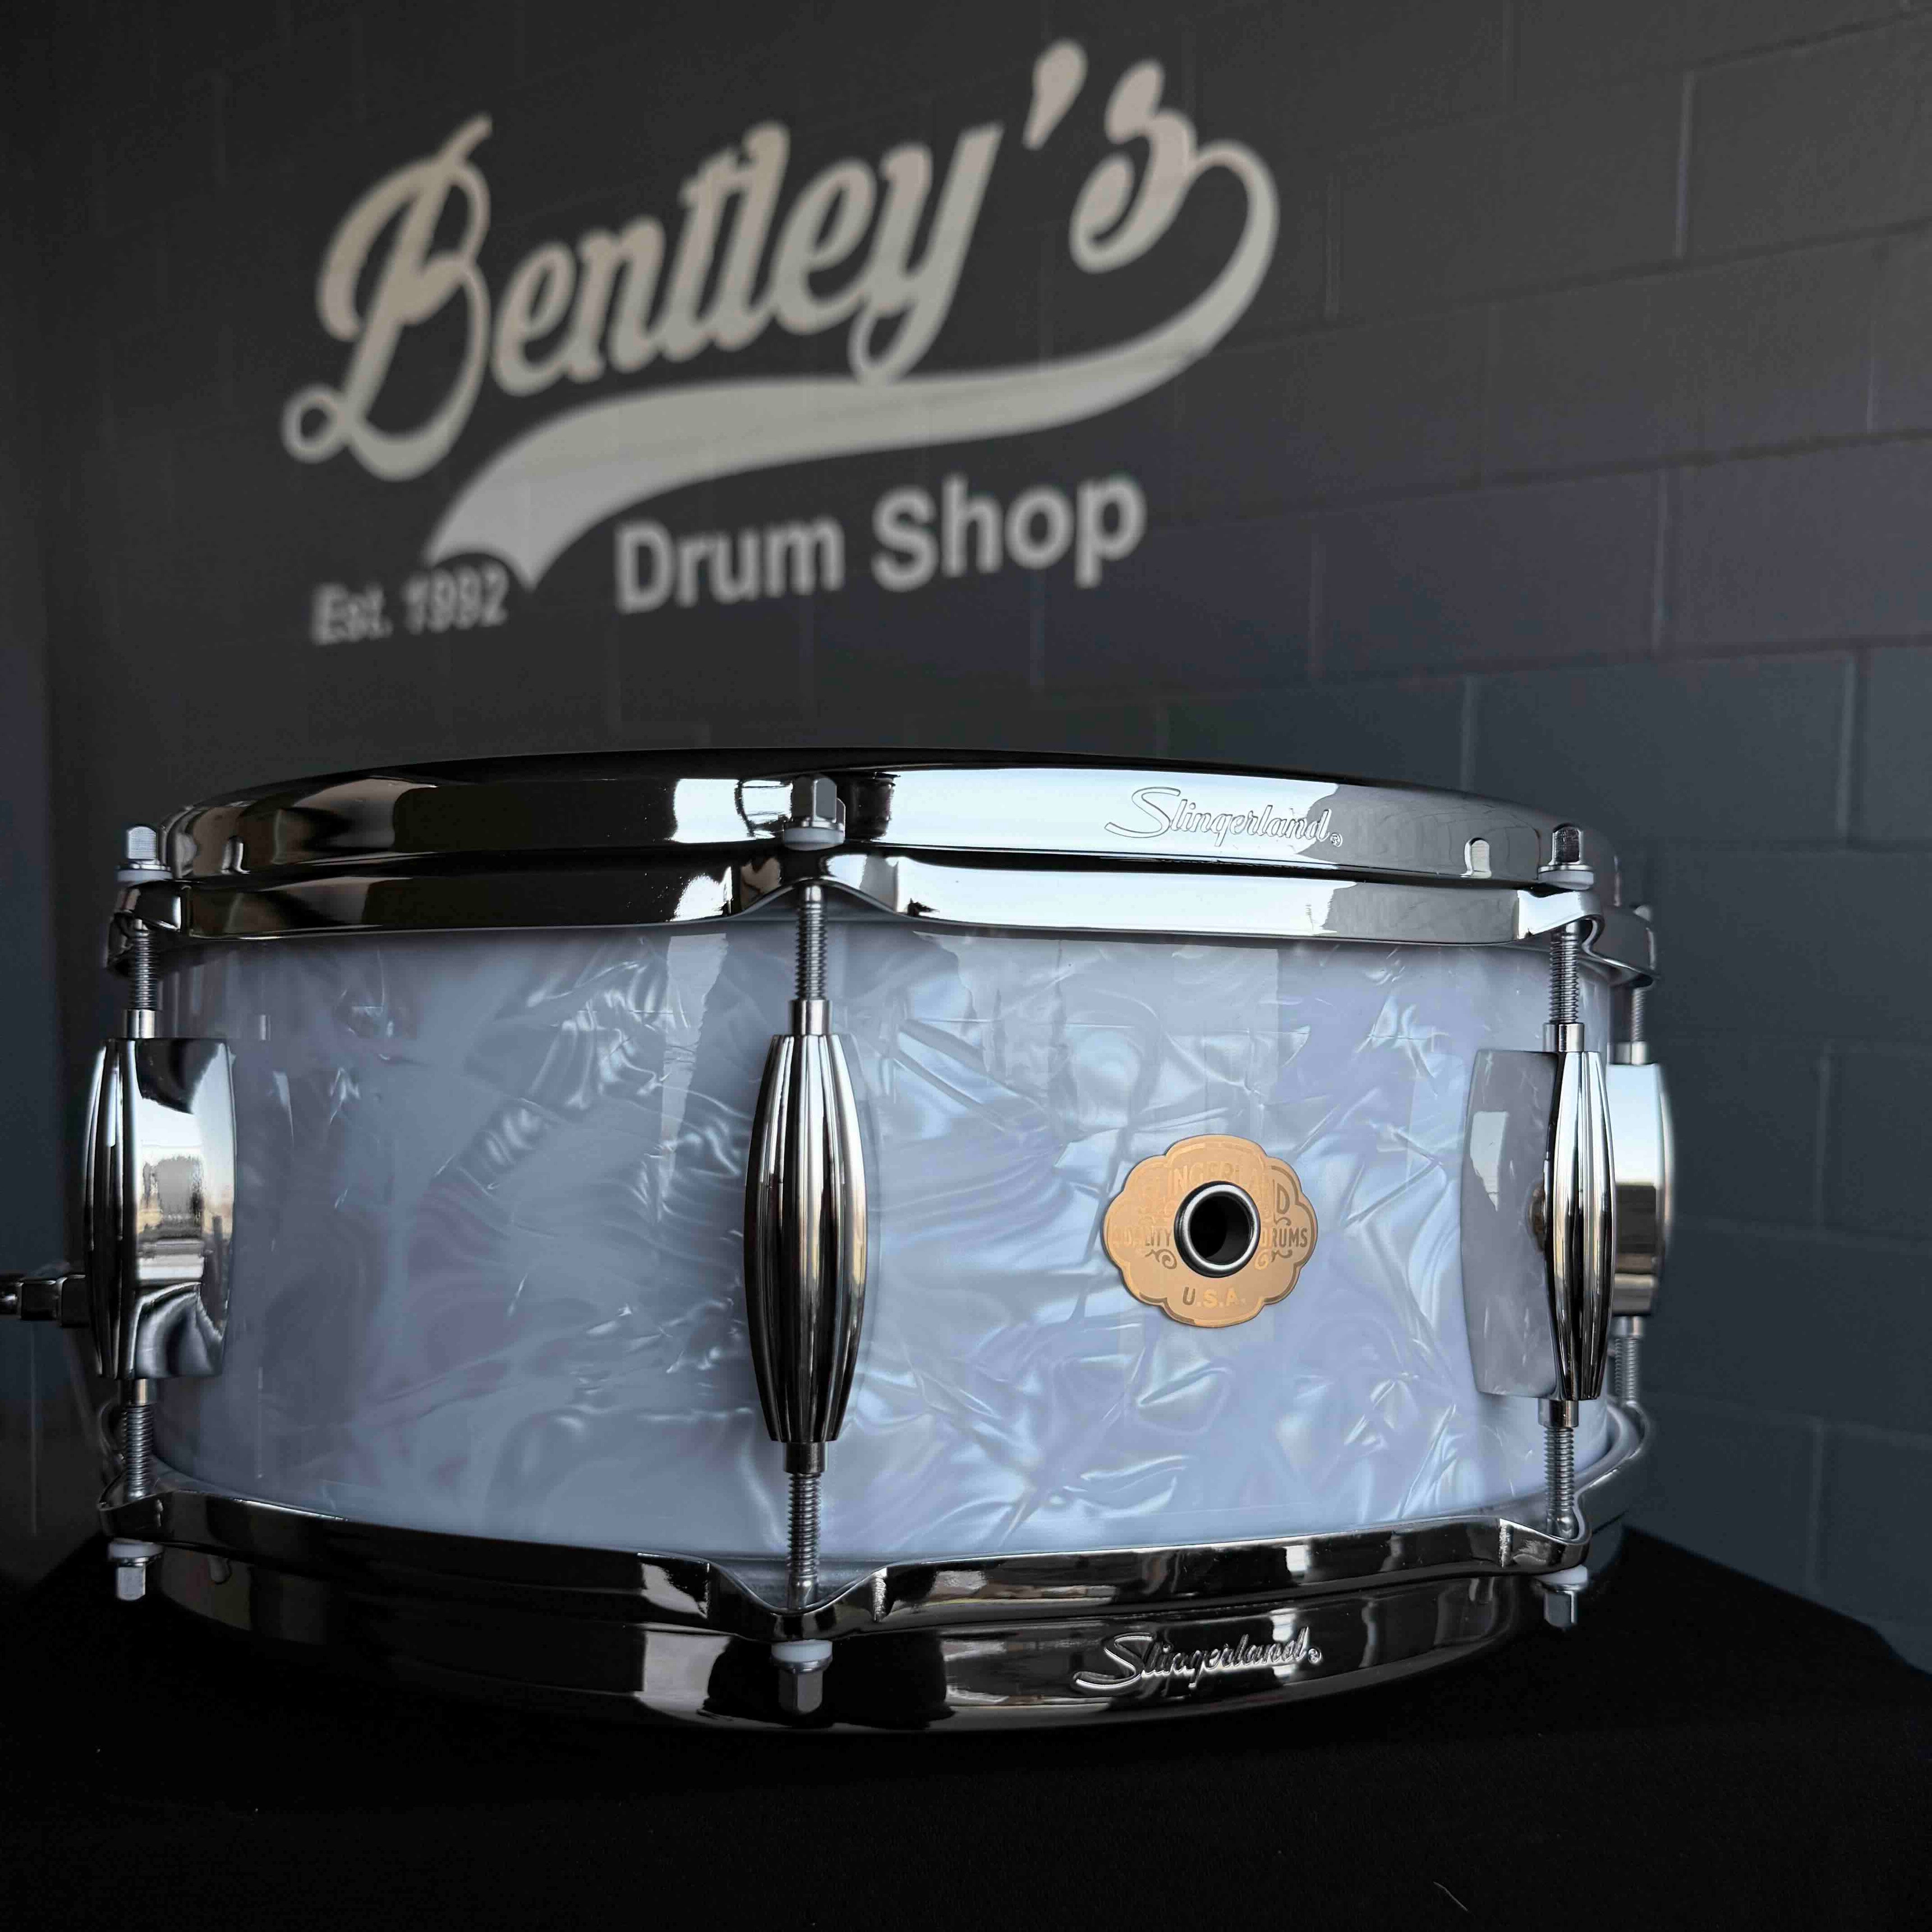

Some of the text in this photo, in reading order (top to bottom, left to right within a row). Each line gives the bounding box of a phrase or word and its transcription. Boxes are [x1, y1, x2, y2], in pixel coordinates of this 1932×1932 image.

[284, 40, 1280, 480] Bentley's
[615, 473, 1146, 613] Drum Shop
[312, 564, 509, 645] Est. 1992
[1260, 1227, 1308, 1248] DRUMS
